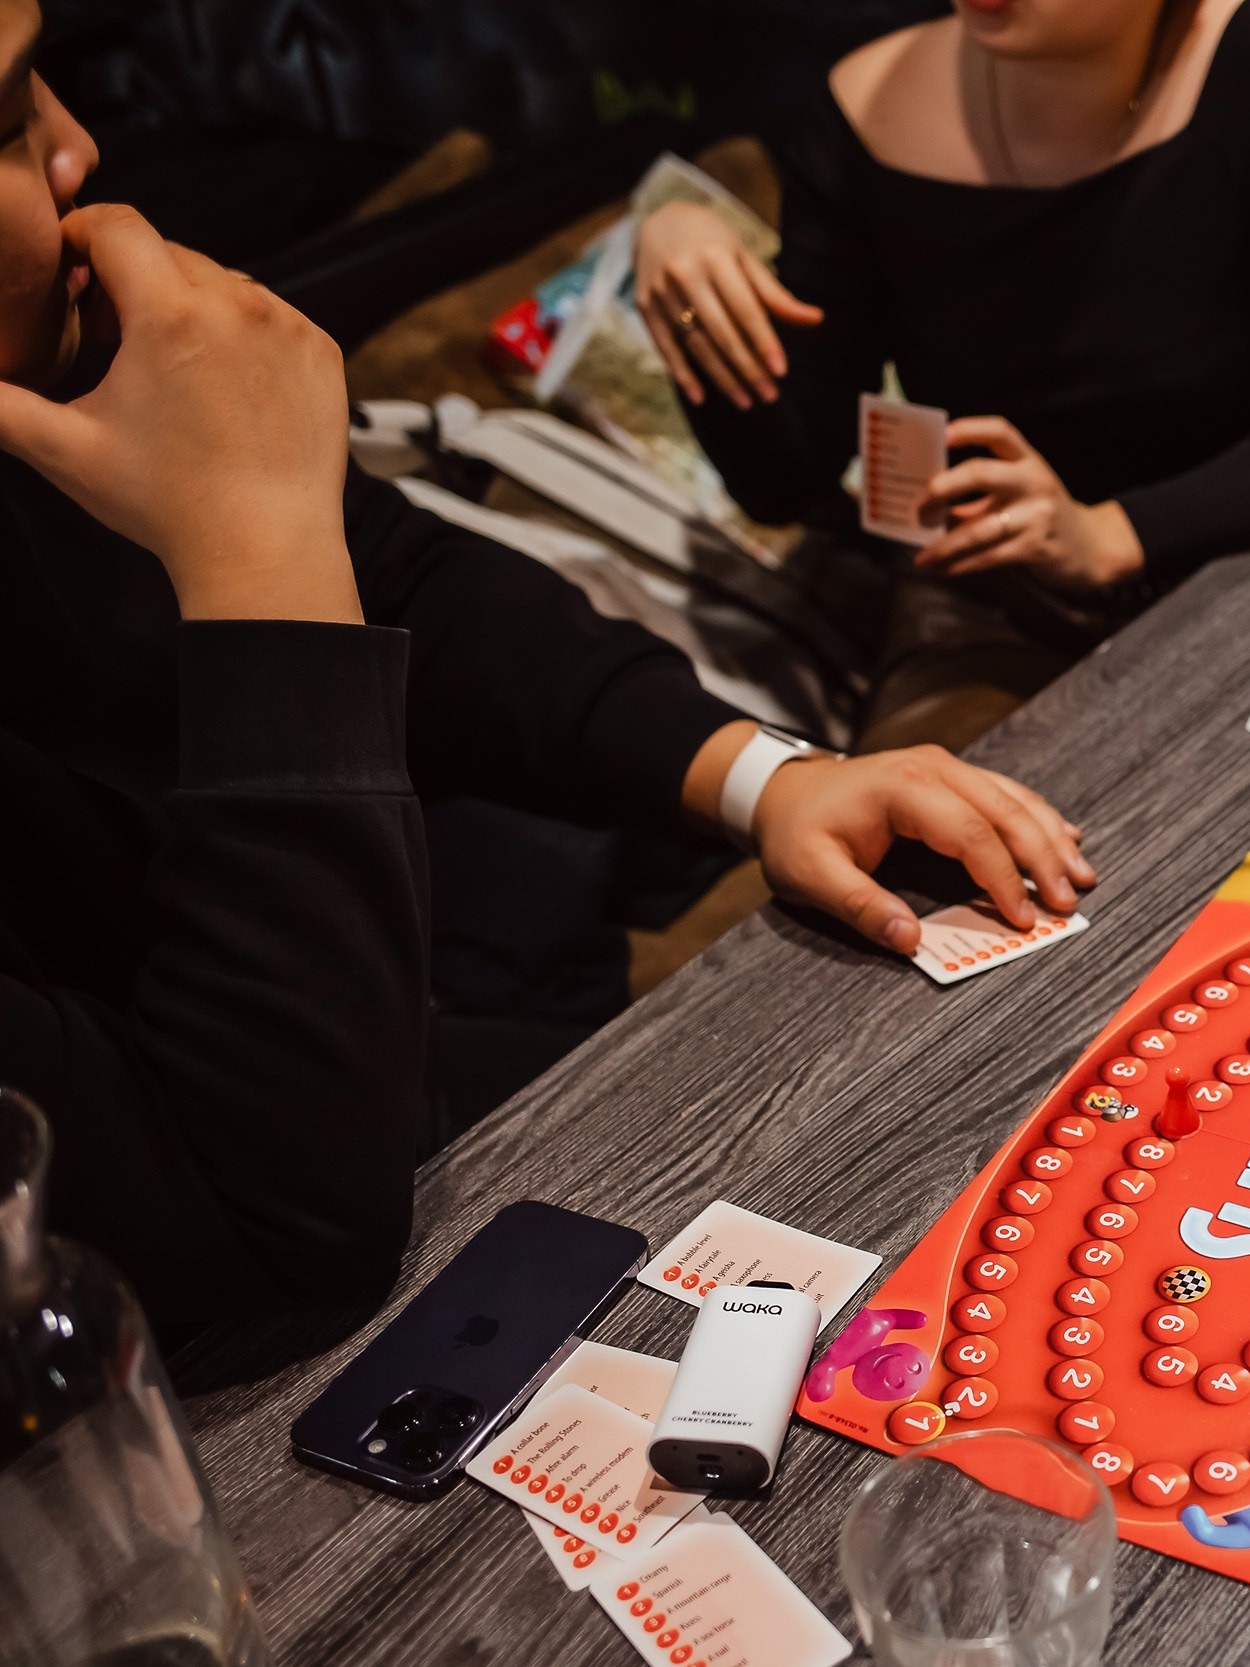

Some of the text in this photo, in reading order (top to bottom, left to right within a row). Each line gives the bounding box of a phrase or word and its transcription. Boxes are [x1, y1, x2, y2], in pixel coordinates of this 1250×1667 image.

[1205, 985, 1229, 1000] 6
[1174, 1011, 1198, 1024] 5
[1143, 1036, 1164, 1049] 4
[1113, 1063, 1136, 1077] 3
[1085, 1094, 1108, 1107] 2
[1196, 1087, 1222, 1102] 2
[1062, 1127, 1083, 1136] 1
[1139, 1145, 1164, 1159] 8
[1036, 1156, 1061, 1170] 8
[1120, 1179, 1145, 1194] 7
[1017, 1189, 1041, 1204] 7
[1100, 1213, 1124, 1228] 6
[996, 1225, 1020, 1240] 6
[680, 1243, 701, 1262] bubble
[697, 1234, 712, 1249] level
[1086, 1248, 1111, 1265] 5
[684, 1278, 695, 1286] 2
[698, 1249, 722, 1271] fairytale
[718, 1260, 736, 1278] geisha
[735, 1259, 763, 1285] saxophone
[980, 1262, 1006, 1279] 5
[803, 1270, 822, 1289] camera
[1071, 1288, 1095, 1304] 4
[722, 1301, 783, 1316] waka
[967, 1303, 991, 1319] 4
[1158, 1315, 1184, 1331] 6
[1064, 1328, 1090, 1344] 3
[960, 1346, 986, 1363] 3
[1158, 1356, 1185, 1374] 5
[1062, 1369, 1091, 1387] 2
[1211, 1373, 1237, 1390] 4
[958, 1387, 987, 1406] 2
[691, 1410, 738, 1418] BLUEBERRY
[704, 1418, 753, 1427] CRANBERRY
[905, 1417, 929, 1430] 1
[1074, 1417, 1099, 1429] 1
[516, 1434, 535, 1451] collar
[531, 1422, 550, 1437] bone
[515, 1419, 582, 1479] 2 The Rolling Stones
[532, 1480, 542, 1488] 3
[560, 1445, 580, 1461] alarm
[1092, 1452, 1121, 1471] 8
[1209, 1462, 1237, 1481] 6
[551, 1490, 559, 1498] 4
[571, 1463, 587, 1477] drop
[567, 1499, 577, 1507] 5
[586, 1466, 612, 1488] wireless
[1148, 1474, 1177, 1494] 7
[585, 1484, 620, 1517] 6 Grease
[633, 1495, 666, 1523] Southeast
[602, 1500, 631, 1527] 7 Nice
[570, 1538, 577, 1547] 7
[623, 1564, 669, 1595] 1 Creamy
[710, 1572, 732, 1589] range
[635, 1578, 684, 1612] 2 Spanish
[663, 1633, 672, 1642] 4
